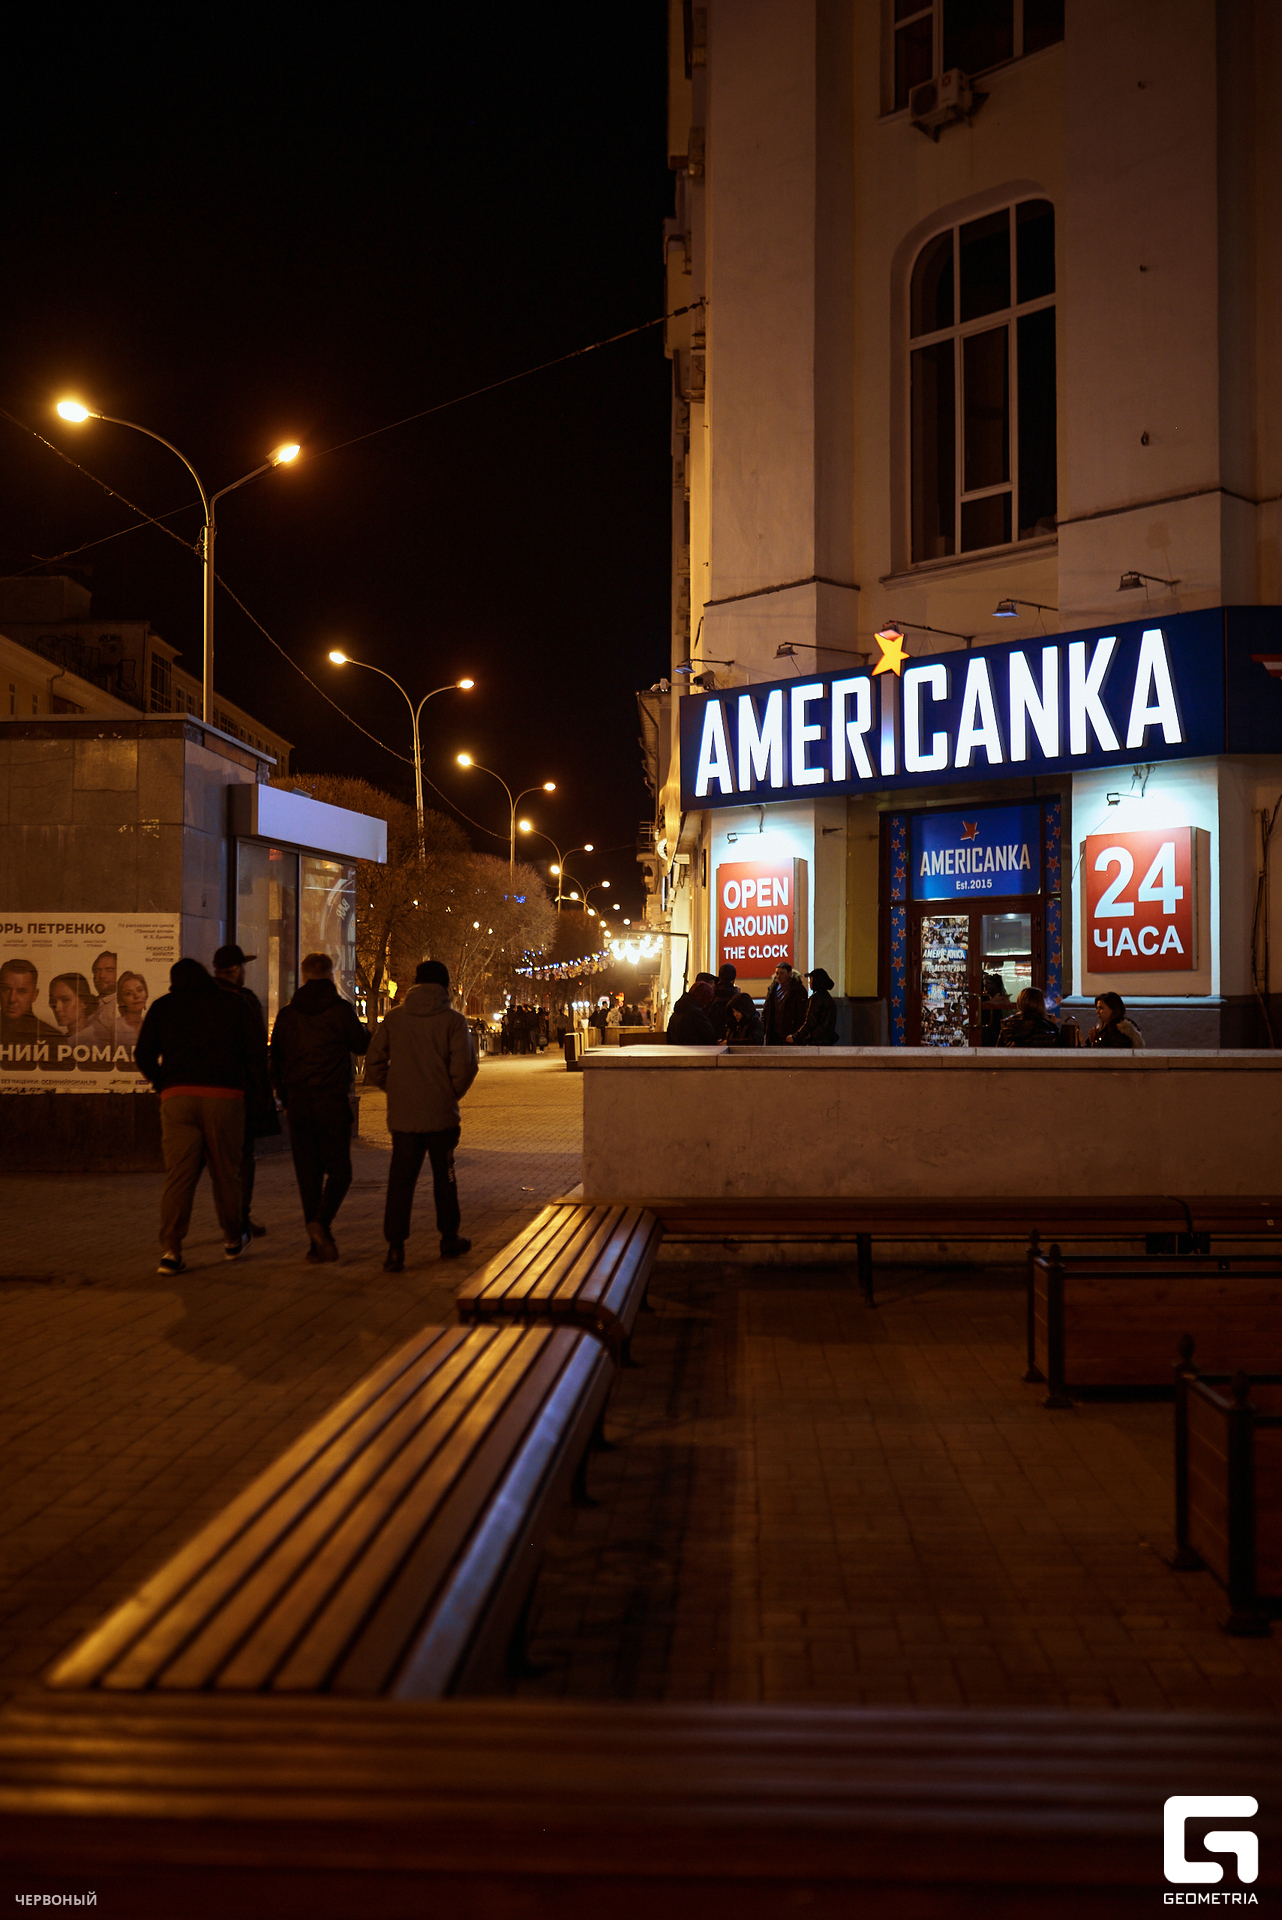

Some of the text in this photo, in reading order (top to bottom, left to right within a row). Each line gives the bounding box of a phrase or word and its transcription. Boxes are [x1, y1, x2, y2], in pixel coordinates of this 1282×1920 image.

[694, 627, 1185, 798] AMERICANKA
[919, 843, 1031, 877] AMERICANKA
[723, 876, 789, 910] OPEN
[955, 878, 993, 891] Est.2015
[1094, 841, 1184, 919] 24
[27, 922, 106, 935] ПЕТРЕНКО
[723, 914, 789, 938] AROUND
[723, 944, 789, 960] THE CLOCK
[1093, 924, 1185, 957] ЧАСА
[57, 1044, 136, 1063] РОМА
